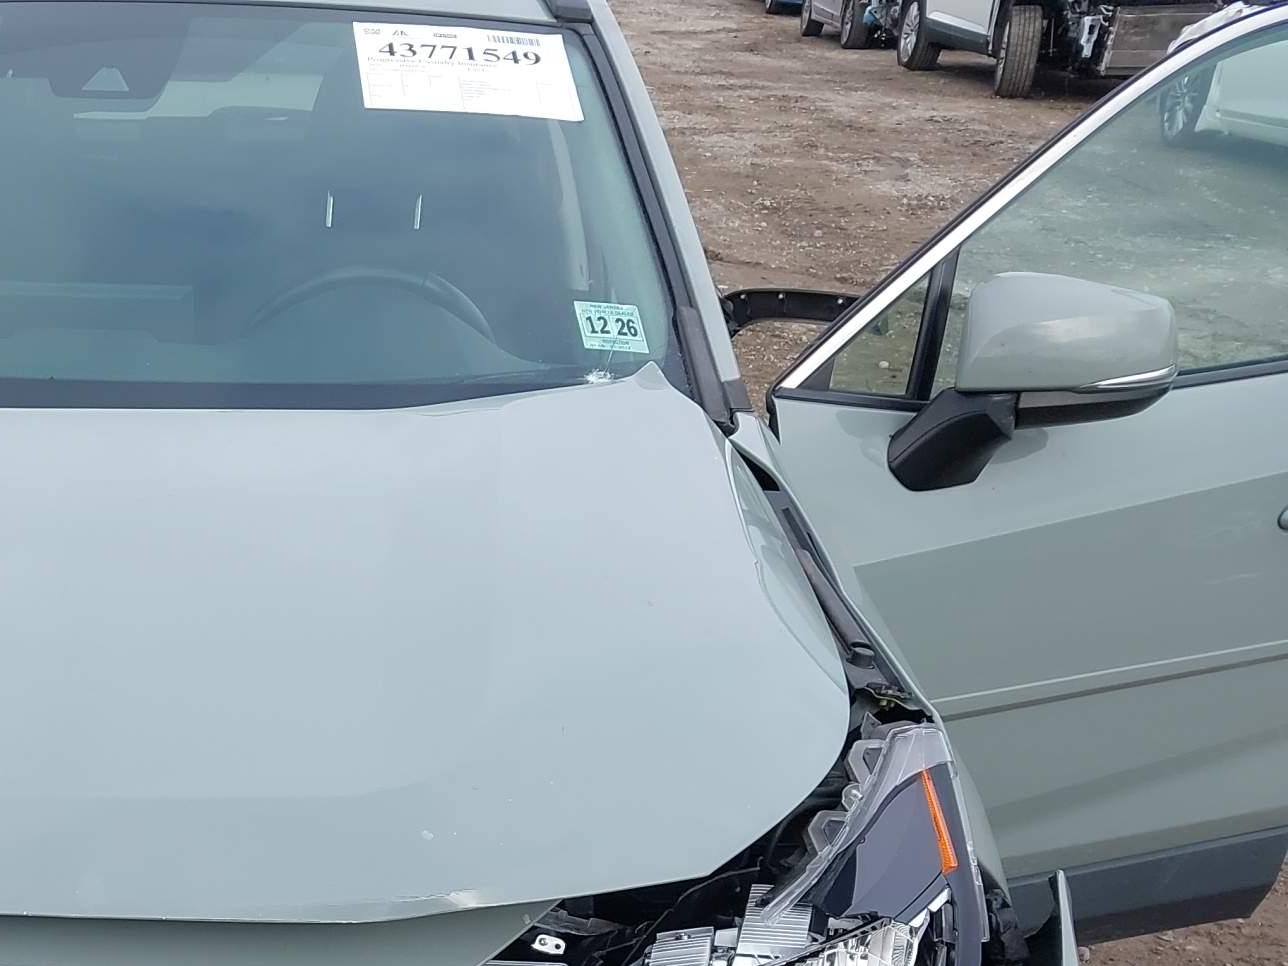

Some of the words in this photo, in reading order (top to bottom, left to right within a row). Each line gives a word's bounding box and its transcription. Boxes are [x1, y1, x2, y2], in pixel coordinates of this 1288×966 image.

[378, 41, 542, 66] 43771549
[586, 316, 611, 334] 12
[615, 317, 638, 337] 26
